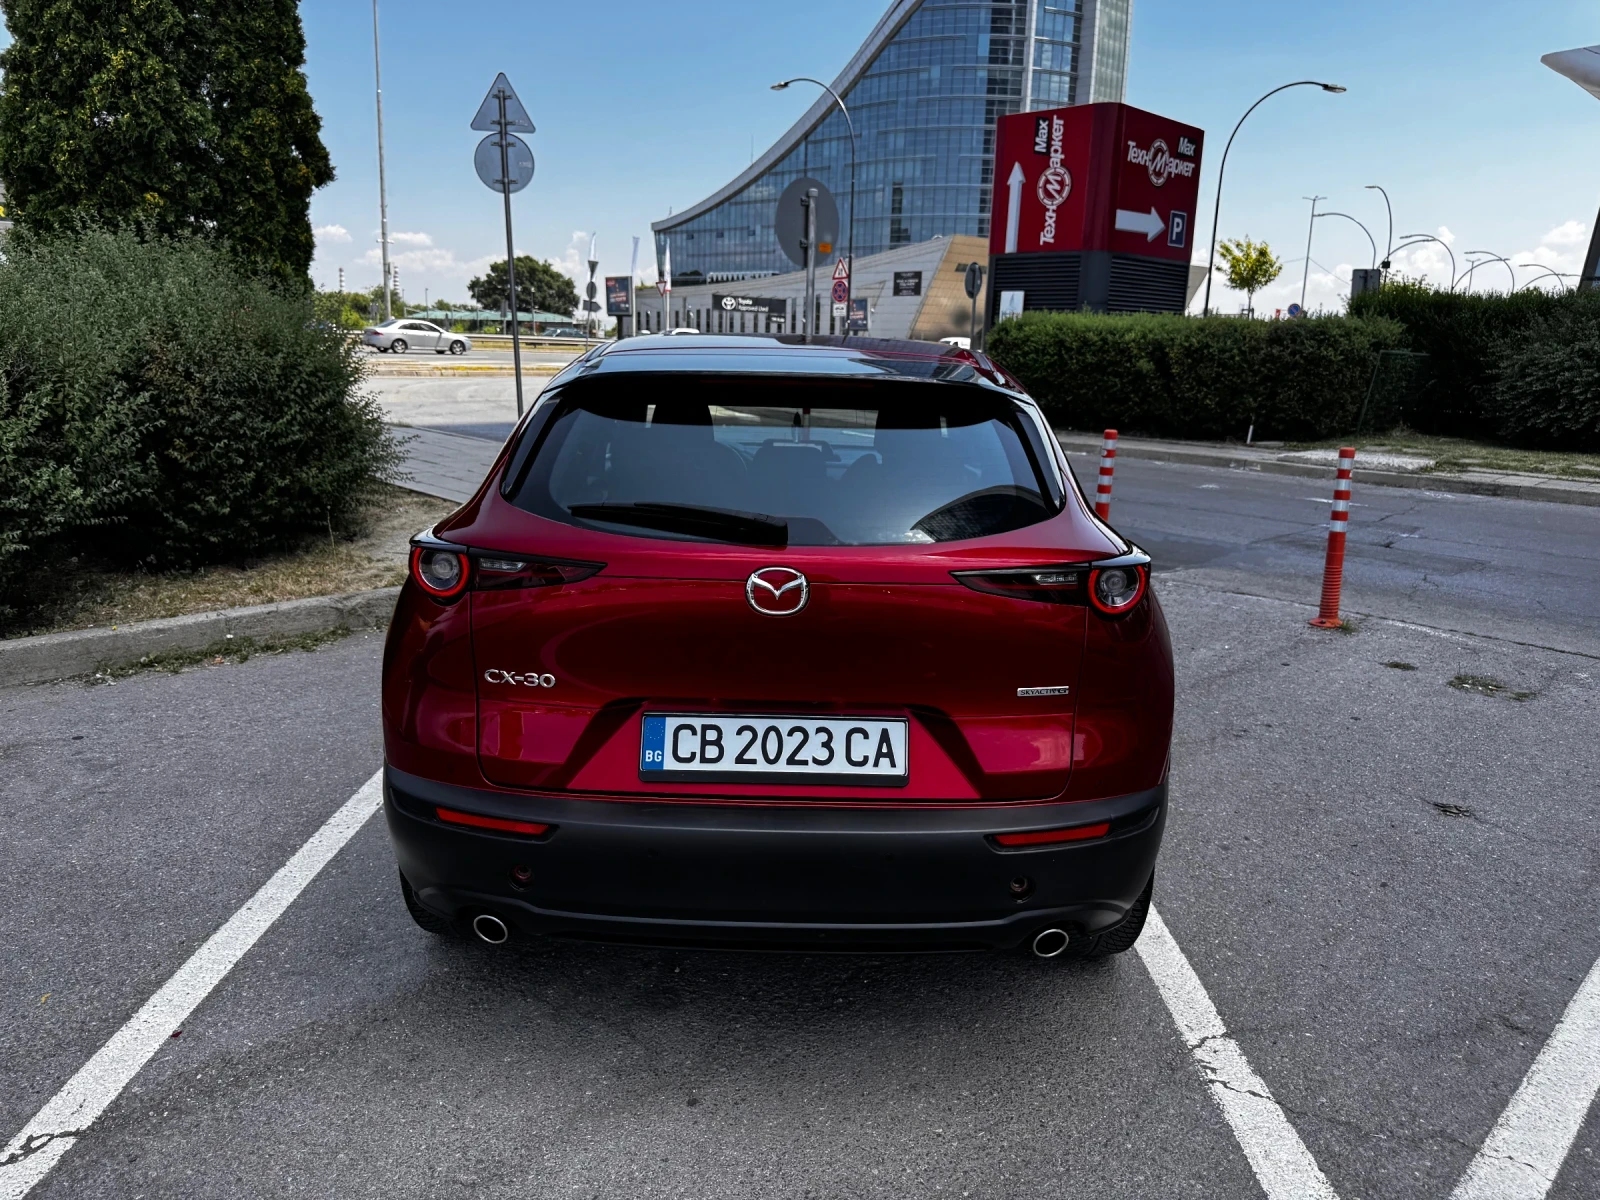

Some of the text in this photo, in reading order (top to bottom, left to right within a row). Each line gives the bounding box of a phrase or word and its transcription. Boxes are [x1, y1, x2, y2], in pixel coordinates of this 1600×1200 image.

[1035, 119, 1048, 153] Max
[1178, 137, 1195, 157] Max
[1172, 217, 1183, 241] P
[484, 668, 556, 688] CX-30
[645, 750, 662, 763] BG
[672, 723, 897, 768] CB 2023 CA
